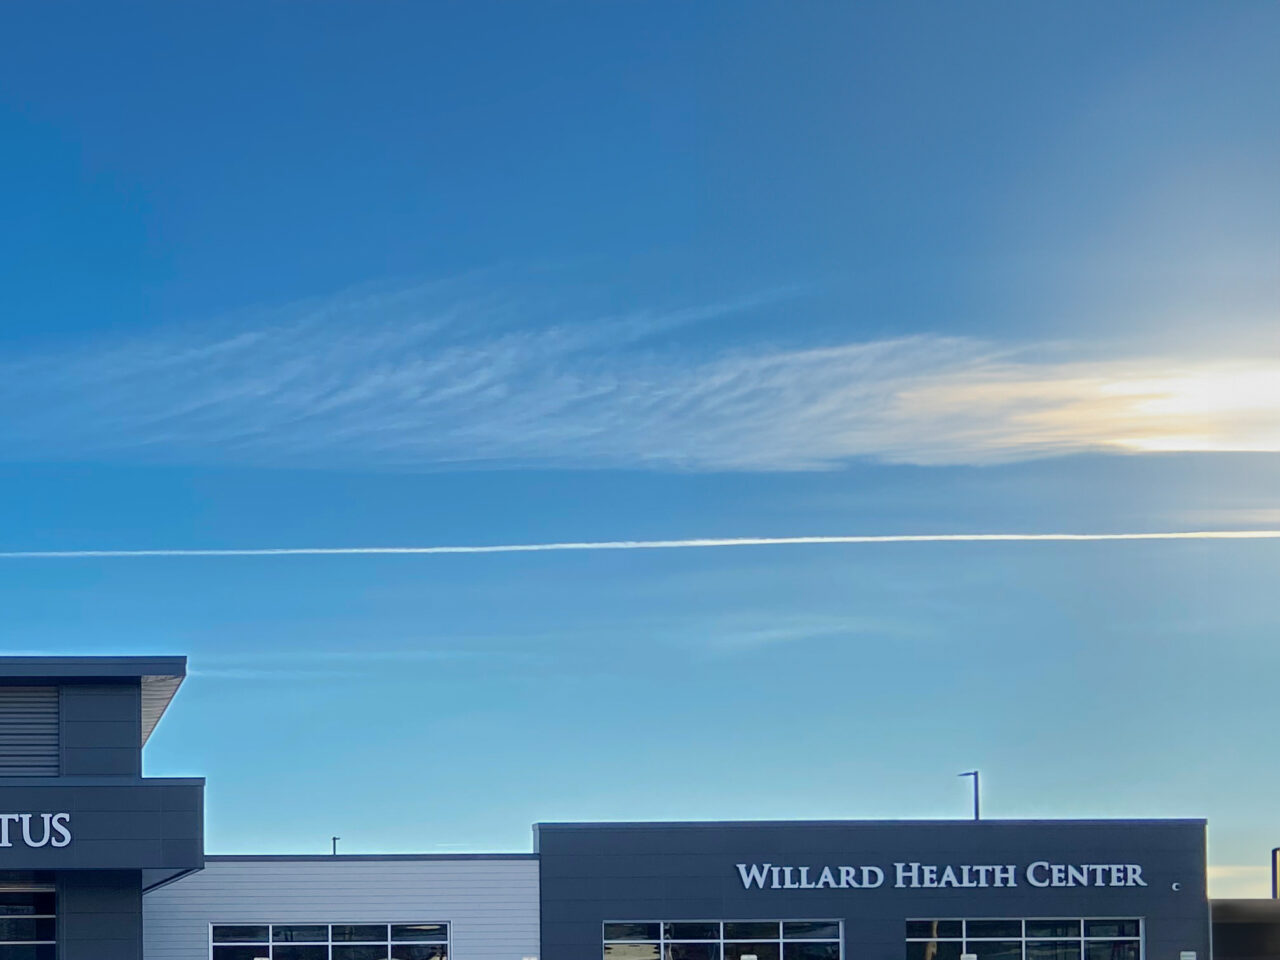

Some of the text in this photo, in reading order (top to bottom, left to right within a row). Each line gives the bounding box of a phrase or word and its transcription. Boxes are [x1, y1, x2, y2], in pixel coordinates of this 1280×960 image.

[736, 861, 1149, 890] WILLARD HEALTH CENTER
